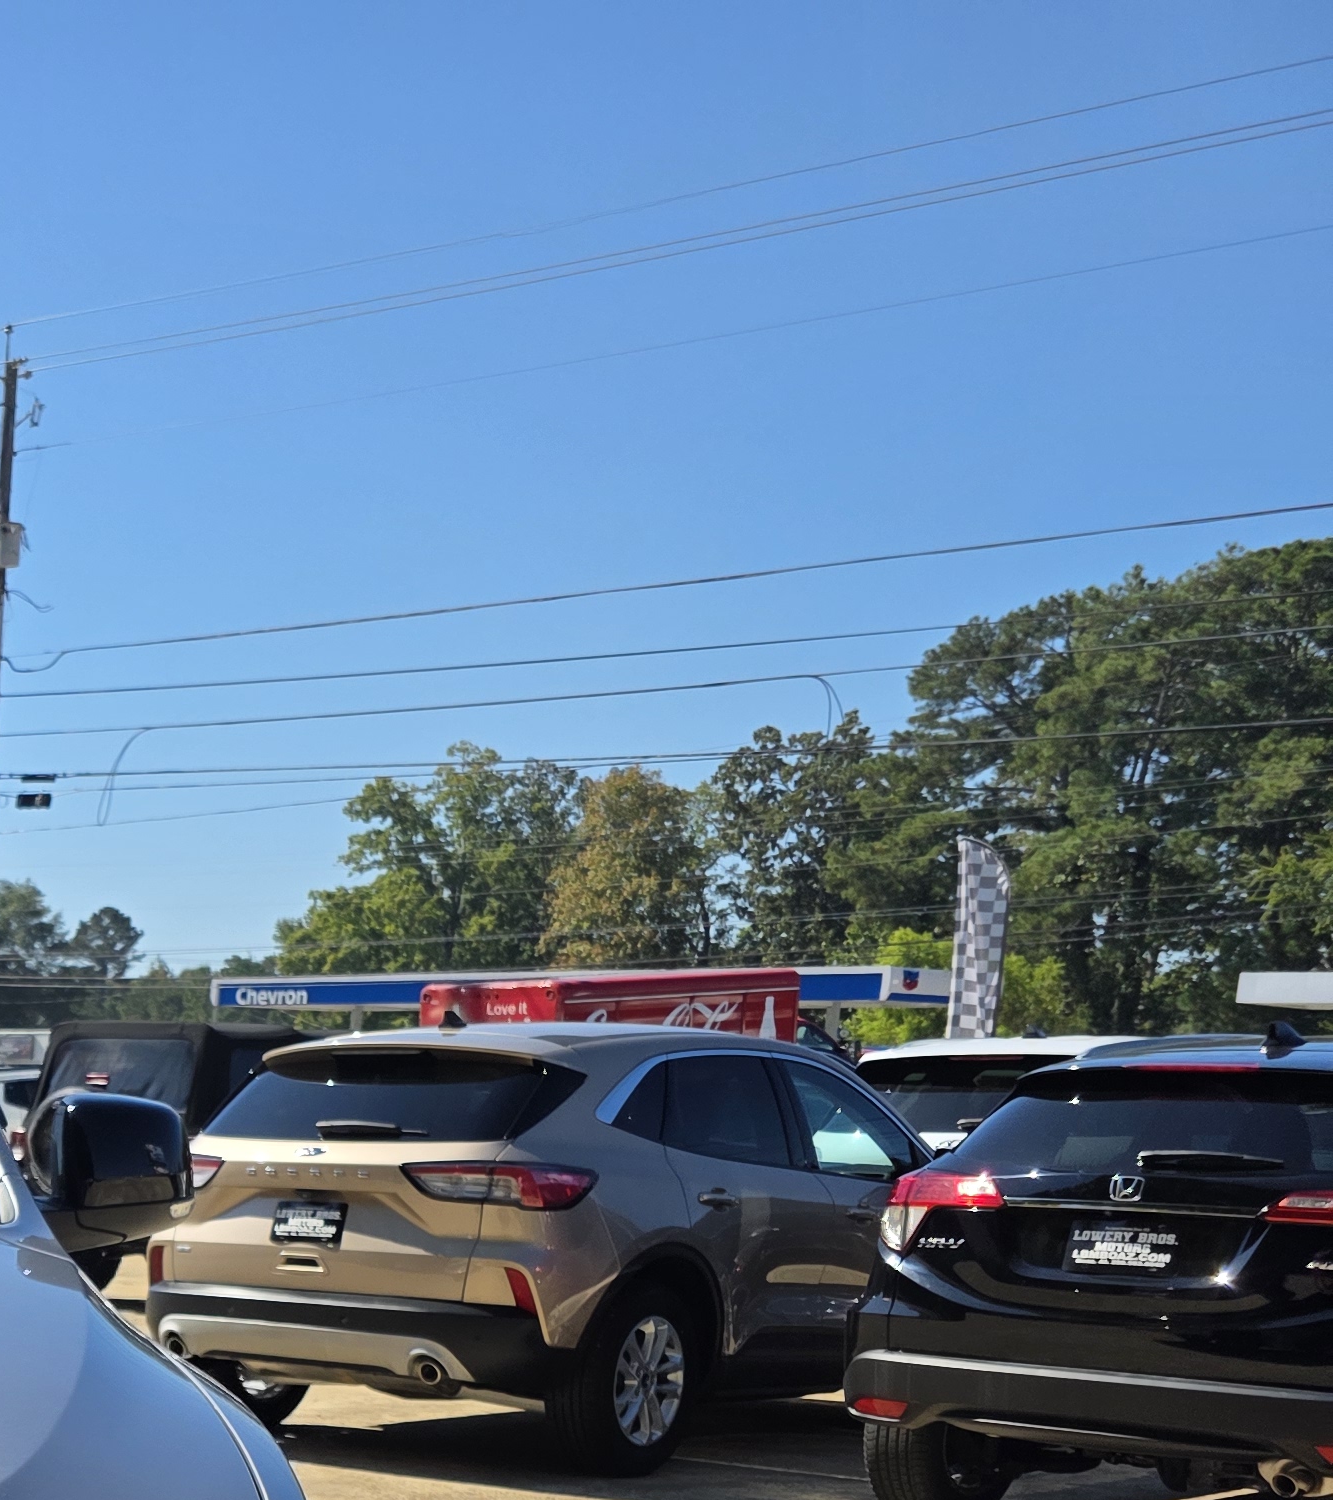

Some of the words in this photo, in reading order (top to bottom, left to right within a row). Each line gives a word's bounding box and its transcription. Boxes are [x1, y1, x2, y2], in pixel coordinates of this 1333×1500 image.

[235, 986, 309, 1006] Chevron
[486, 1002, 516, 1016] Love
[1072, 1229, 1134, 1242] LOWERY
[1093, 1241, 1152, 1254] MOTORS
